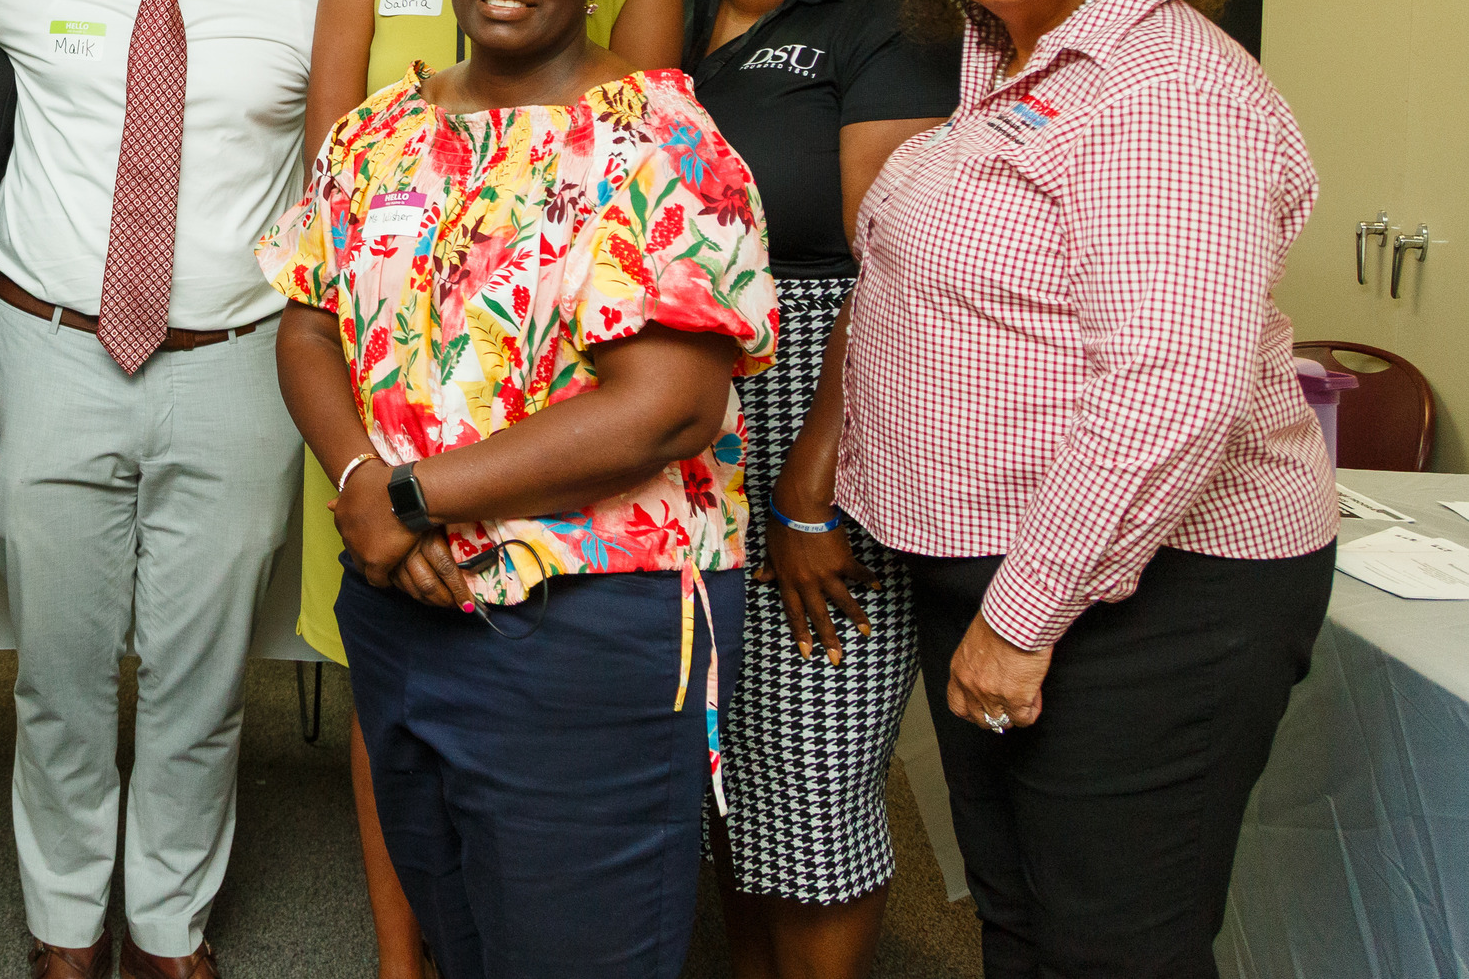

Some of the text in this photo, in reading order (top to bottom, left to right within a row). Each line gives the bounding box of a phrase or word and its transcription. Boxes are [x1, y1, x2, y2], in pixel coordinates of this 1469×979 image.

[65, 21, 89, 30] HELLO
[54, 37, 95, 58] Malik
[742, 44, 826, 70] DSU
[384, 192, 410, 202] HELLO
